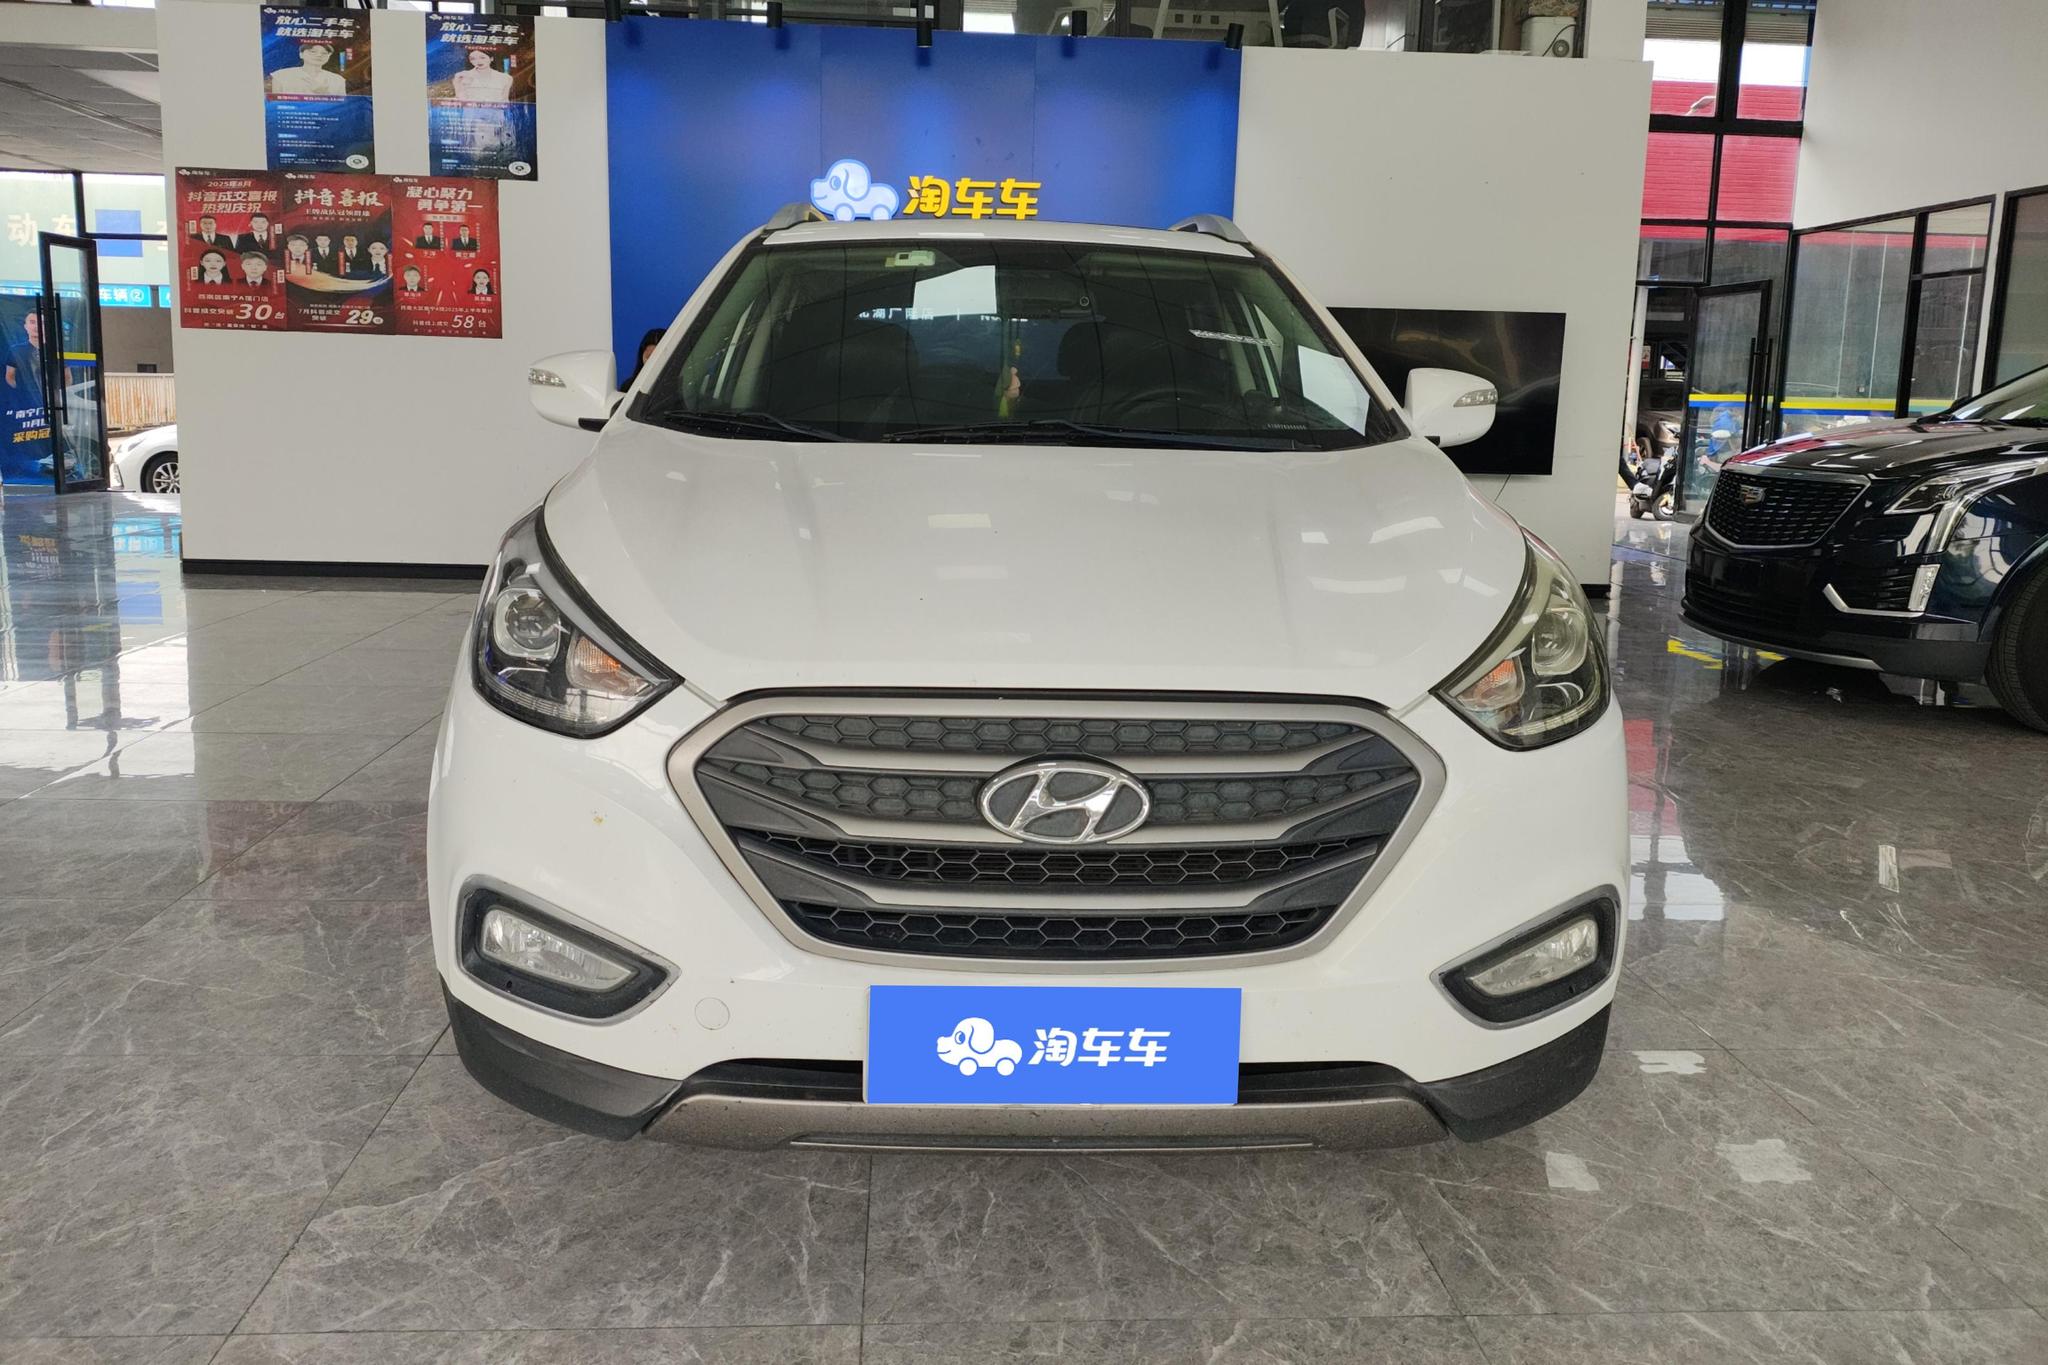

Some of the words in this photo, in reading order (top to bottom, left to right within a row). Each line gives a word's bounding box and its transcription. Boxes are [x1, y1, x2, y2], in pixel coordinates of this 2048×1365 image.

[275, 27, 355, 38] 就选淘车车
[439, 33, 519, 45] 就选淘车车
[188, 190, 278, 202] 抖音成交喜报
[294, 188, 384, 207] 抖音喜报
[406, 186, 473, 200] 凝心聚力
[902, 175, 1042, 220] 淘车车
[201, 202, 262, 214] 热烈庆祝
[417, 199, 483, 213] 勇争第一
[235, 303, 273, 321] 30
[274, 311, 285, 319] 台
[346, 309, 374, 325] 29
[451, 314, 475, 329] 58
[478, 320, 487, 328] 台
